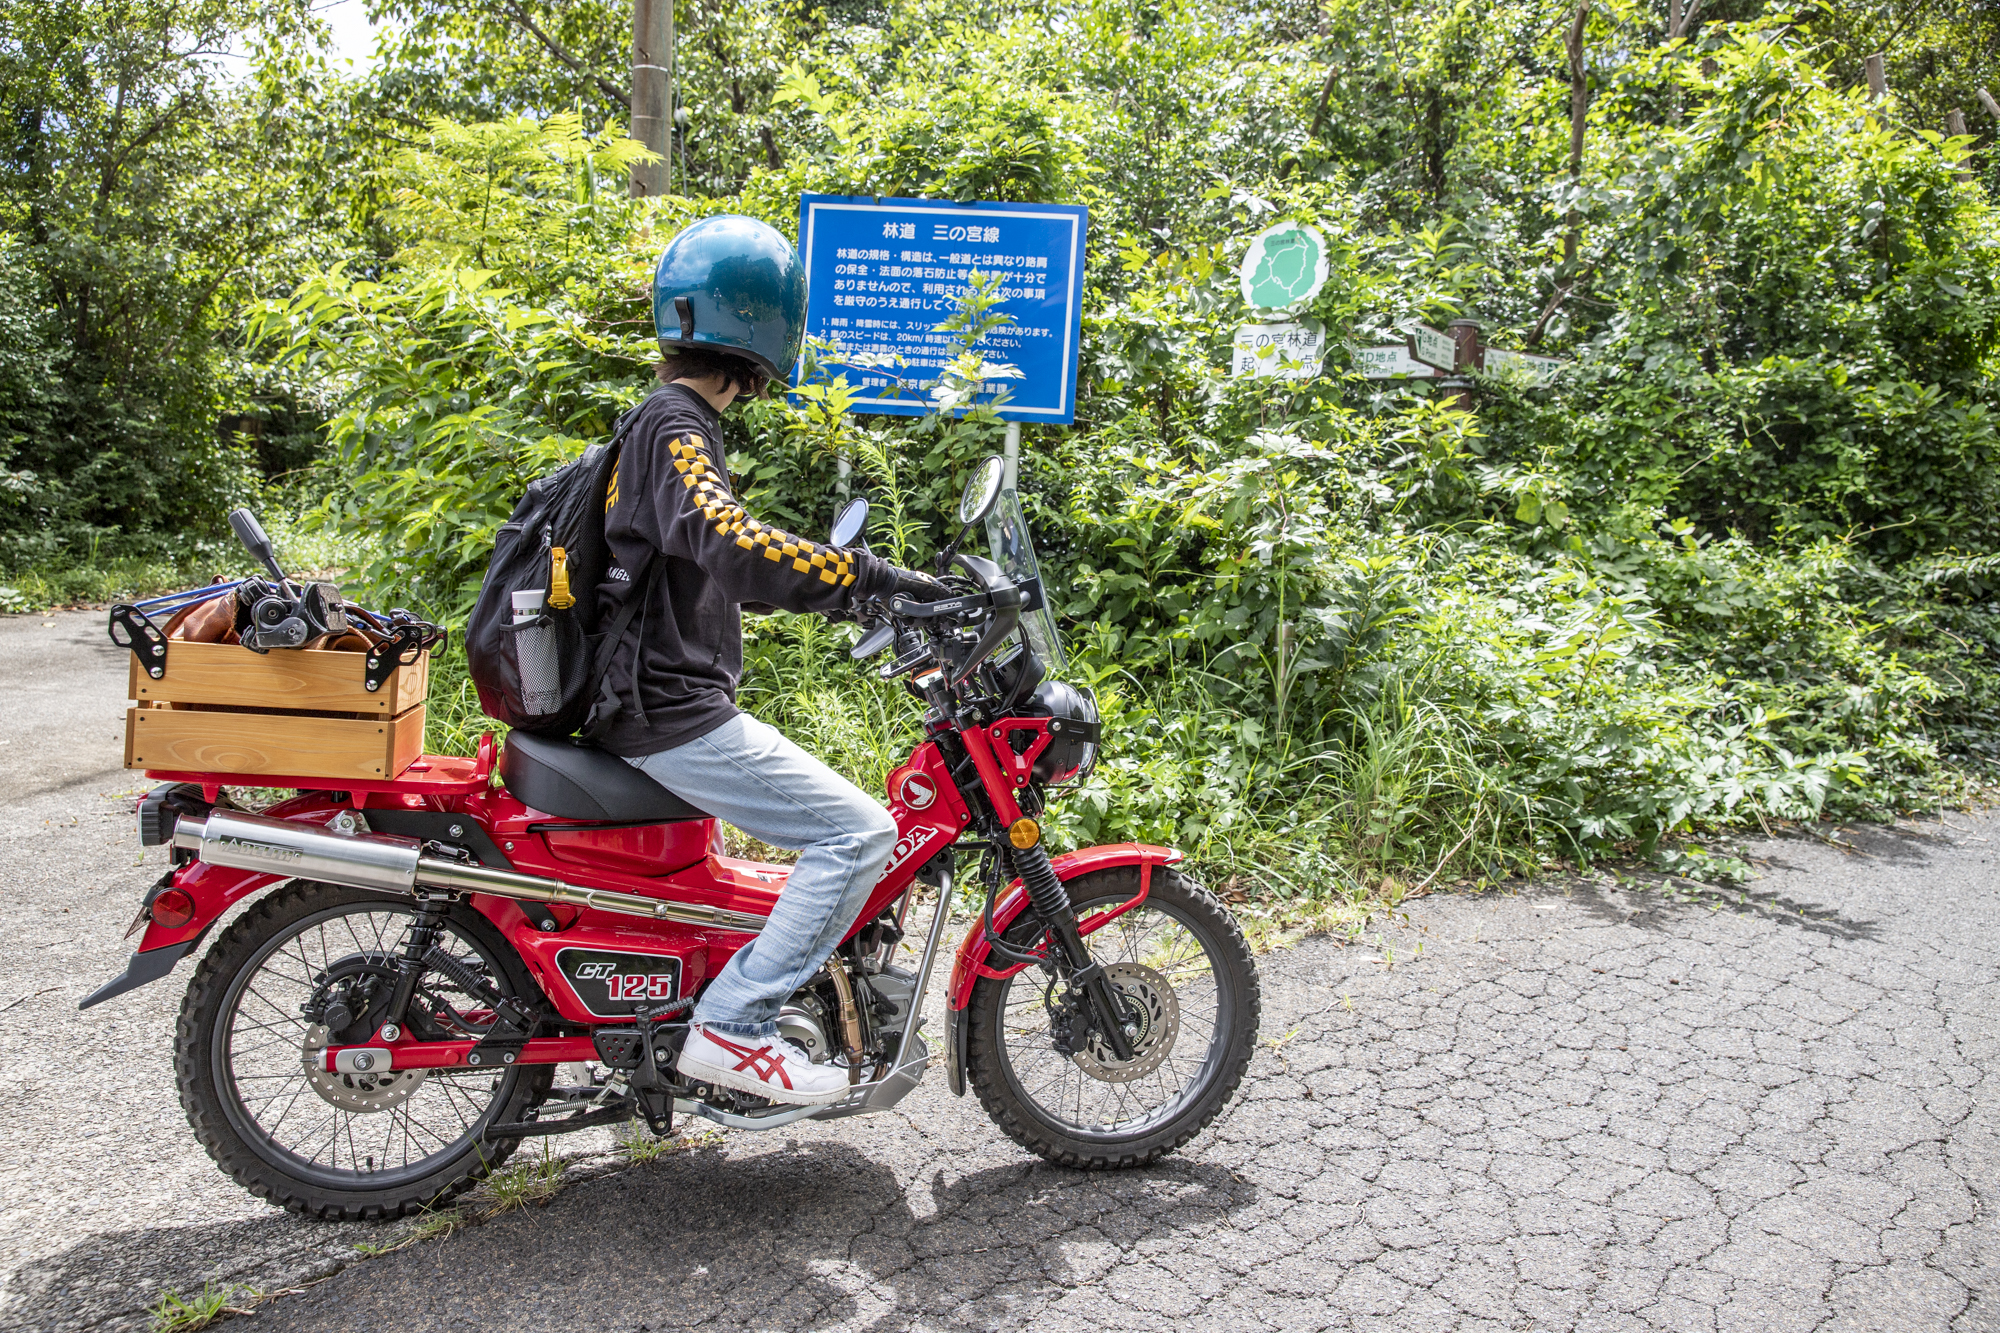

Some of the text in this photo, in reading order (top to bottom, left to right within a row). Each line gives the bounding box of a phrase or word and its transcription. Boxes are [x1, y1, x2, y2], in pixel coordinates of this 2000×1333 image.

[882, 222, 1000, 243] 林道 三の宮線
[835, 264, 1047, 284] の保全・法面の落石防止等処置が十分で
[1366, 351, 1397, 363] D地点
[877, 825, 939, 884] NDA
[575, 963, 672, 1000] CT 125
